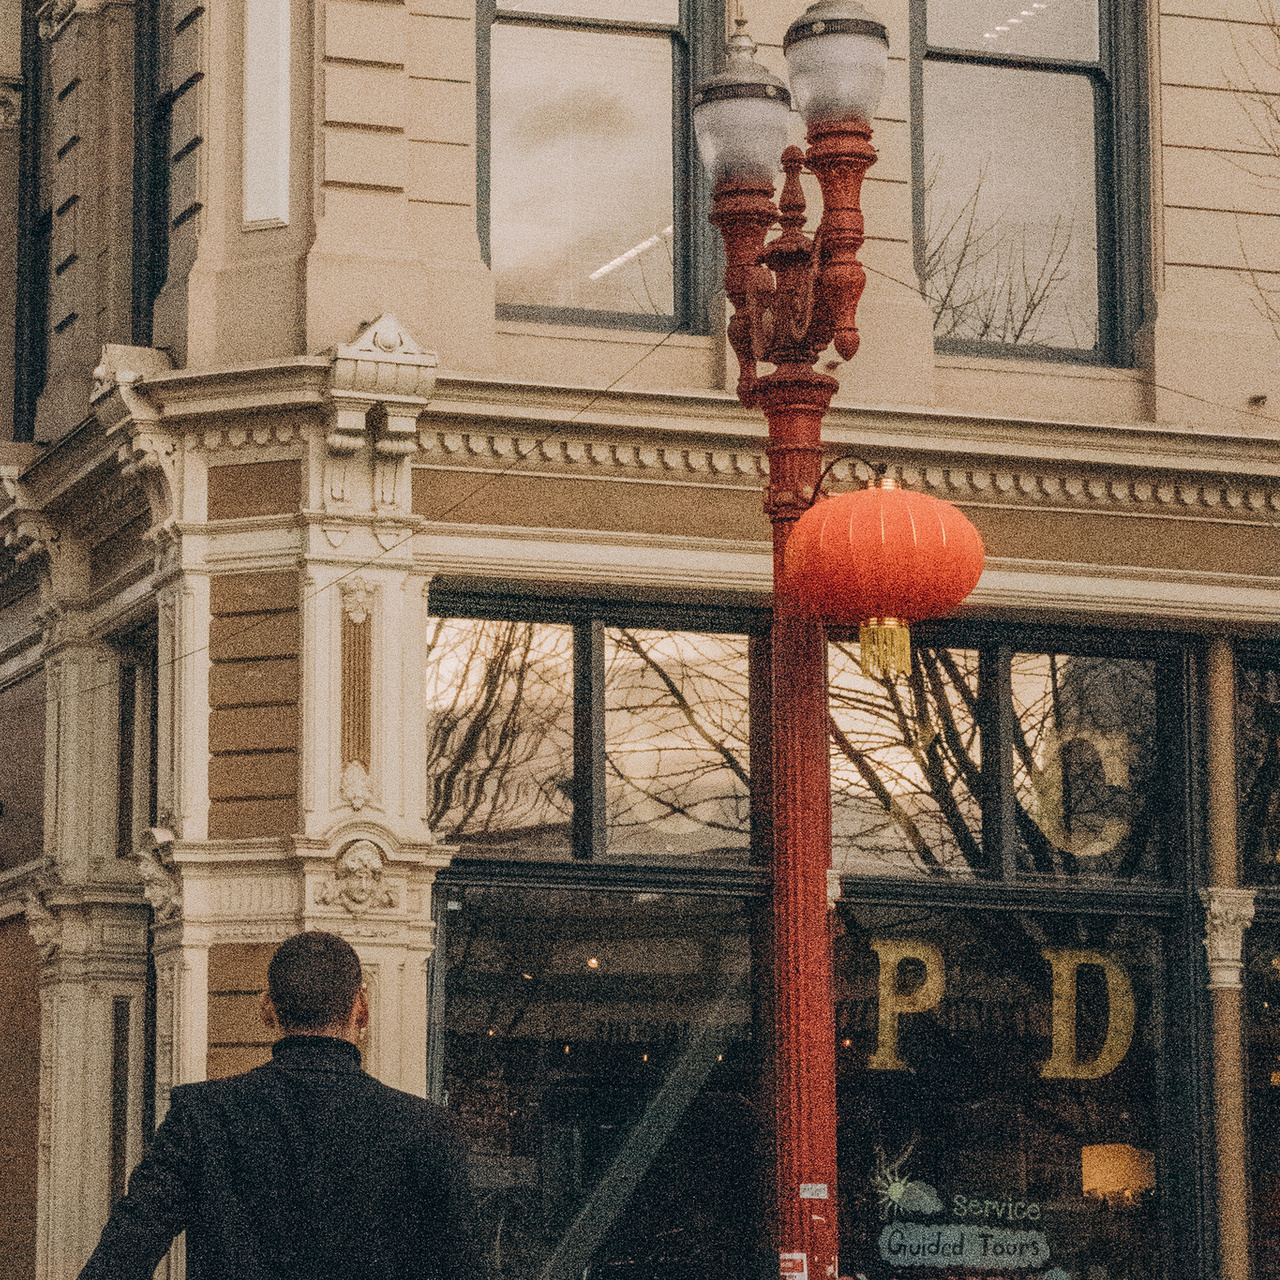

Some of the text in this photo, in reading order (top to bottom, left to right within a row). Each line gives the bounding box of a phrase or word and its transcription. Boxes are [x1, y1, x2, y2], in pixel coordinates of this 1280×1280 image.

[953, 1194, 1041, 1220] Service
[888, 1229, 1039, 1256] Guided Tours
